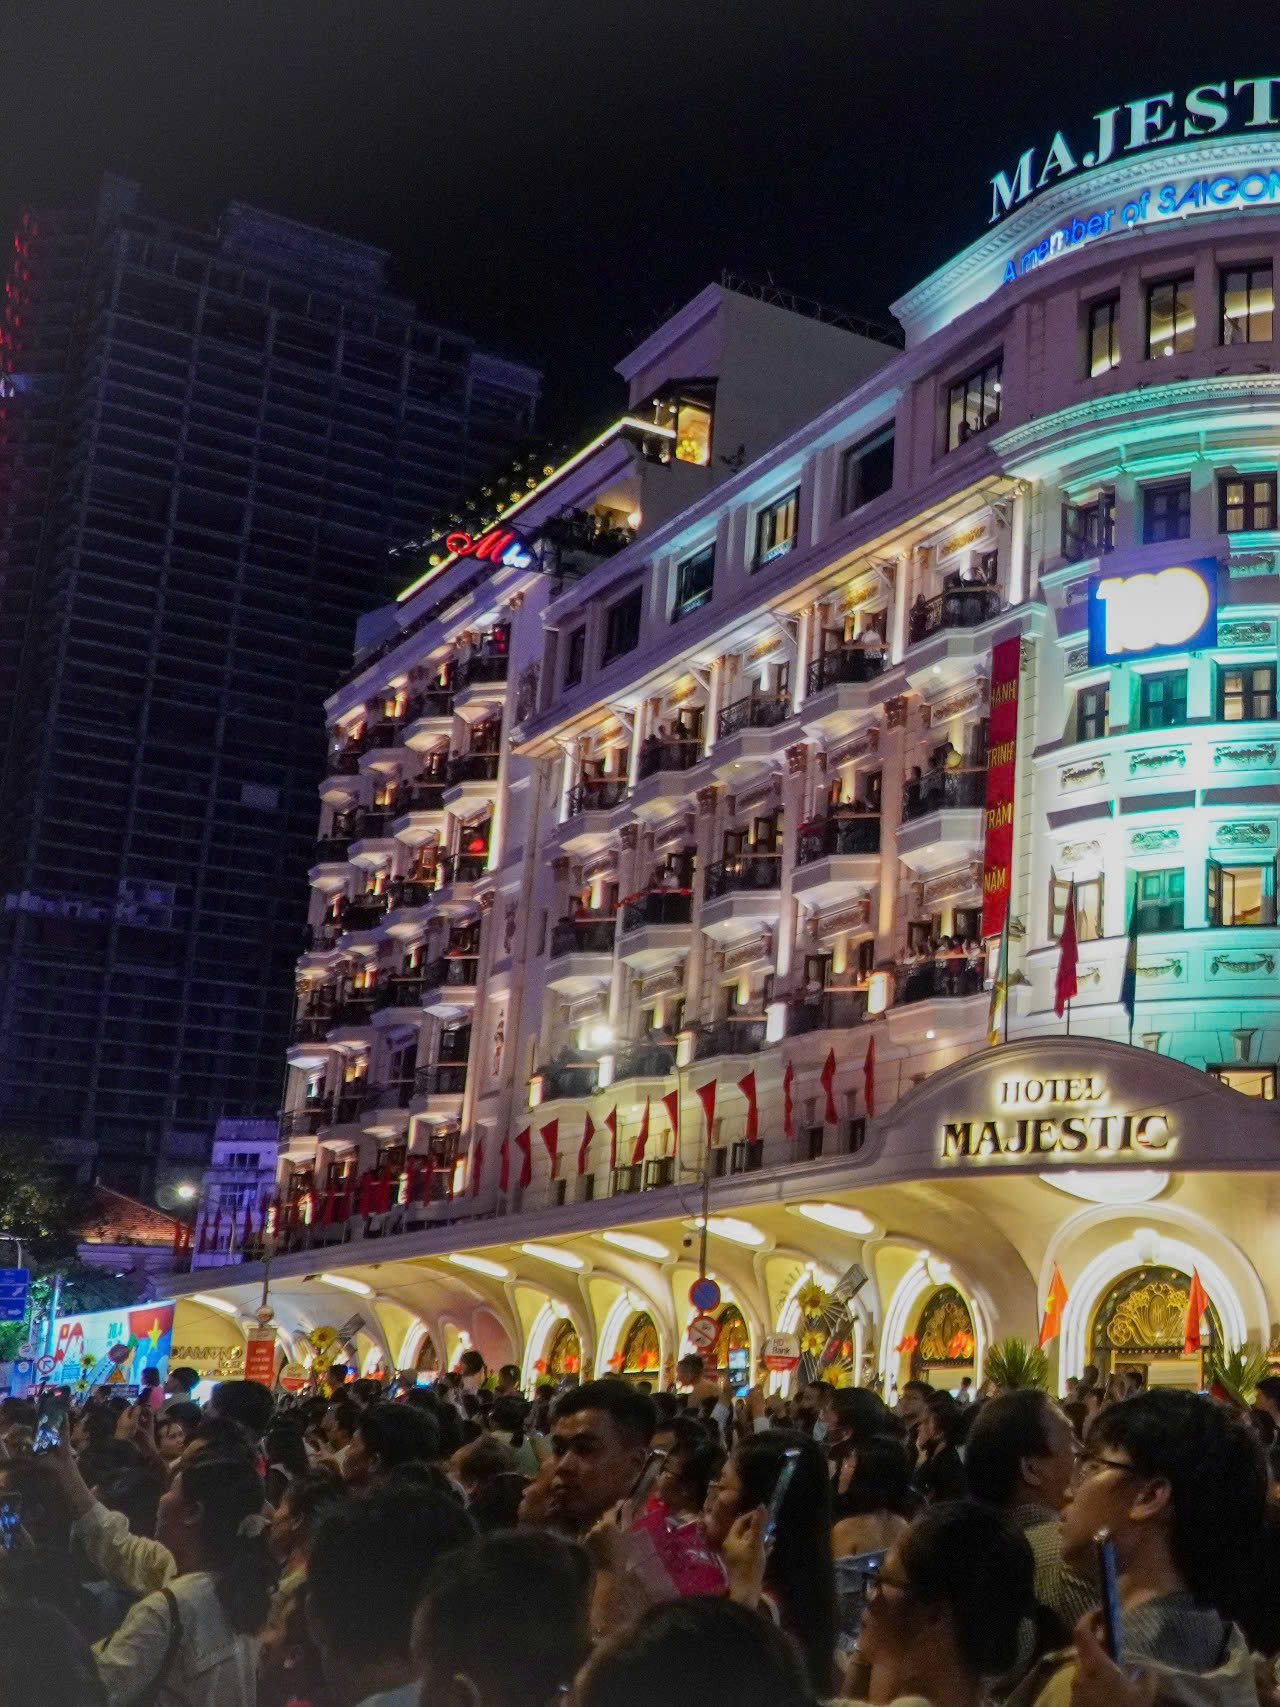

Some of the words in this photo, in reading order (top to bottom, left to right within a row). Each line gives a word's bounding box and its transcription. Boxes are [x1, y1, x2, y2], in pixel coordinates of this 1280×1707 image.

[1002, 259, 1017, 281] A
[1019, 207, 1114, 275] member
[1120, 190, 1151, 229] of
[984, 866, 1006, 893] NĂM
[1001, 1077, 1104, 1104] HOTEL
[942, 1114, 1176, 1158] MAJESTIC
